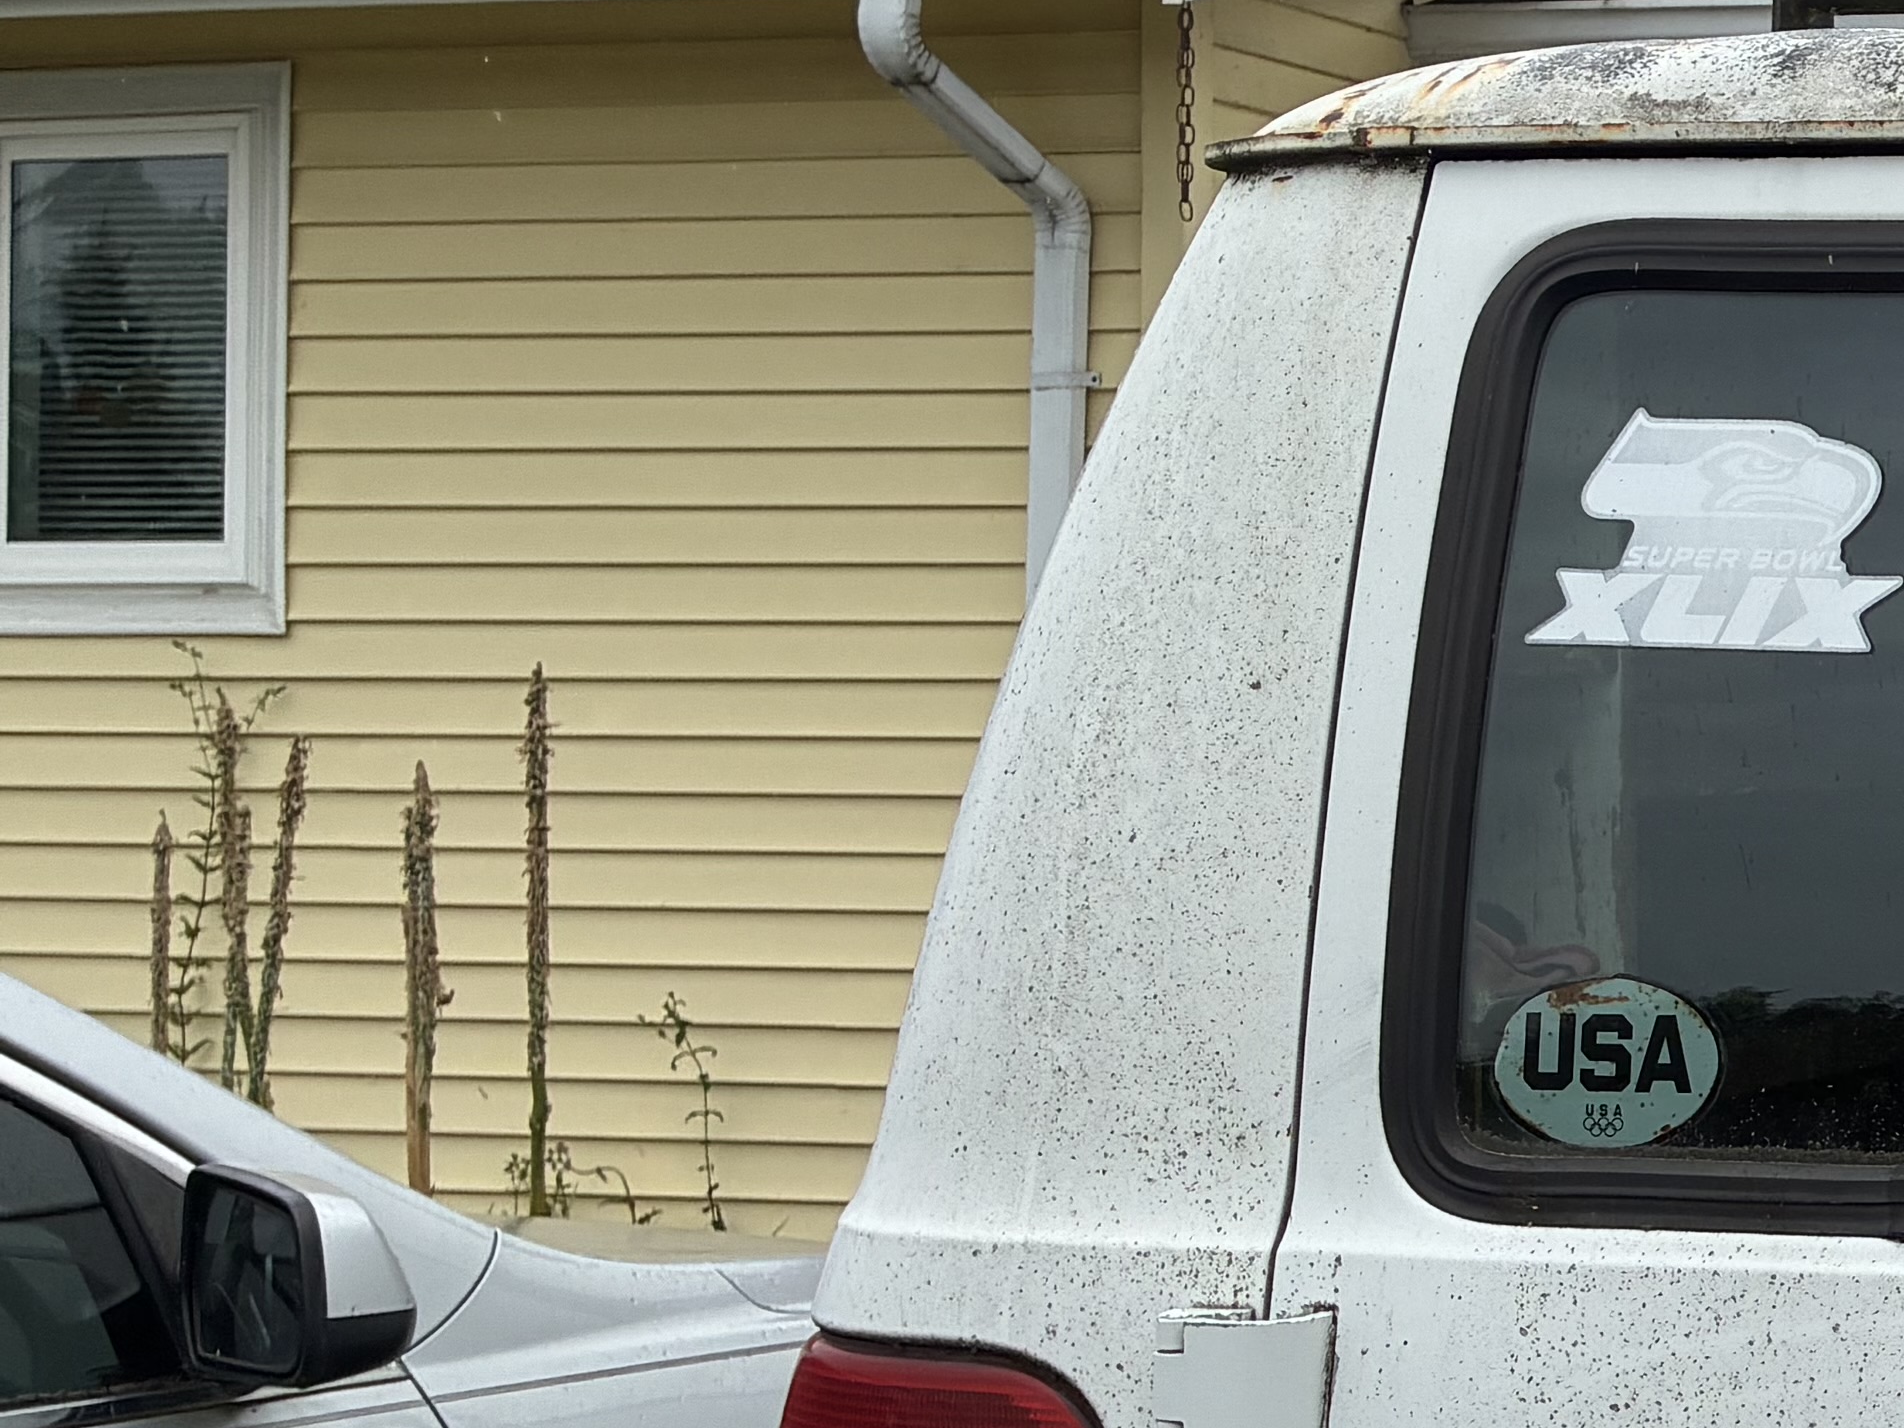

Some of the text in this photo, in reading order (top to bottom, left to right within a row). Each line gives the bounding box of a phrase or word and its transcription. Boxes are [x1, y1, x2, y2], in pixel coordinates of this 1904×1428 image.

[1621, 545, 1842, 572] SUPER BOWL
[1530, 571, 1902, 649] XLIX
[1523, 1012, 1692, 1093] USA
